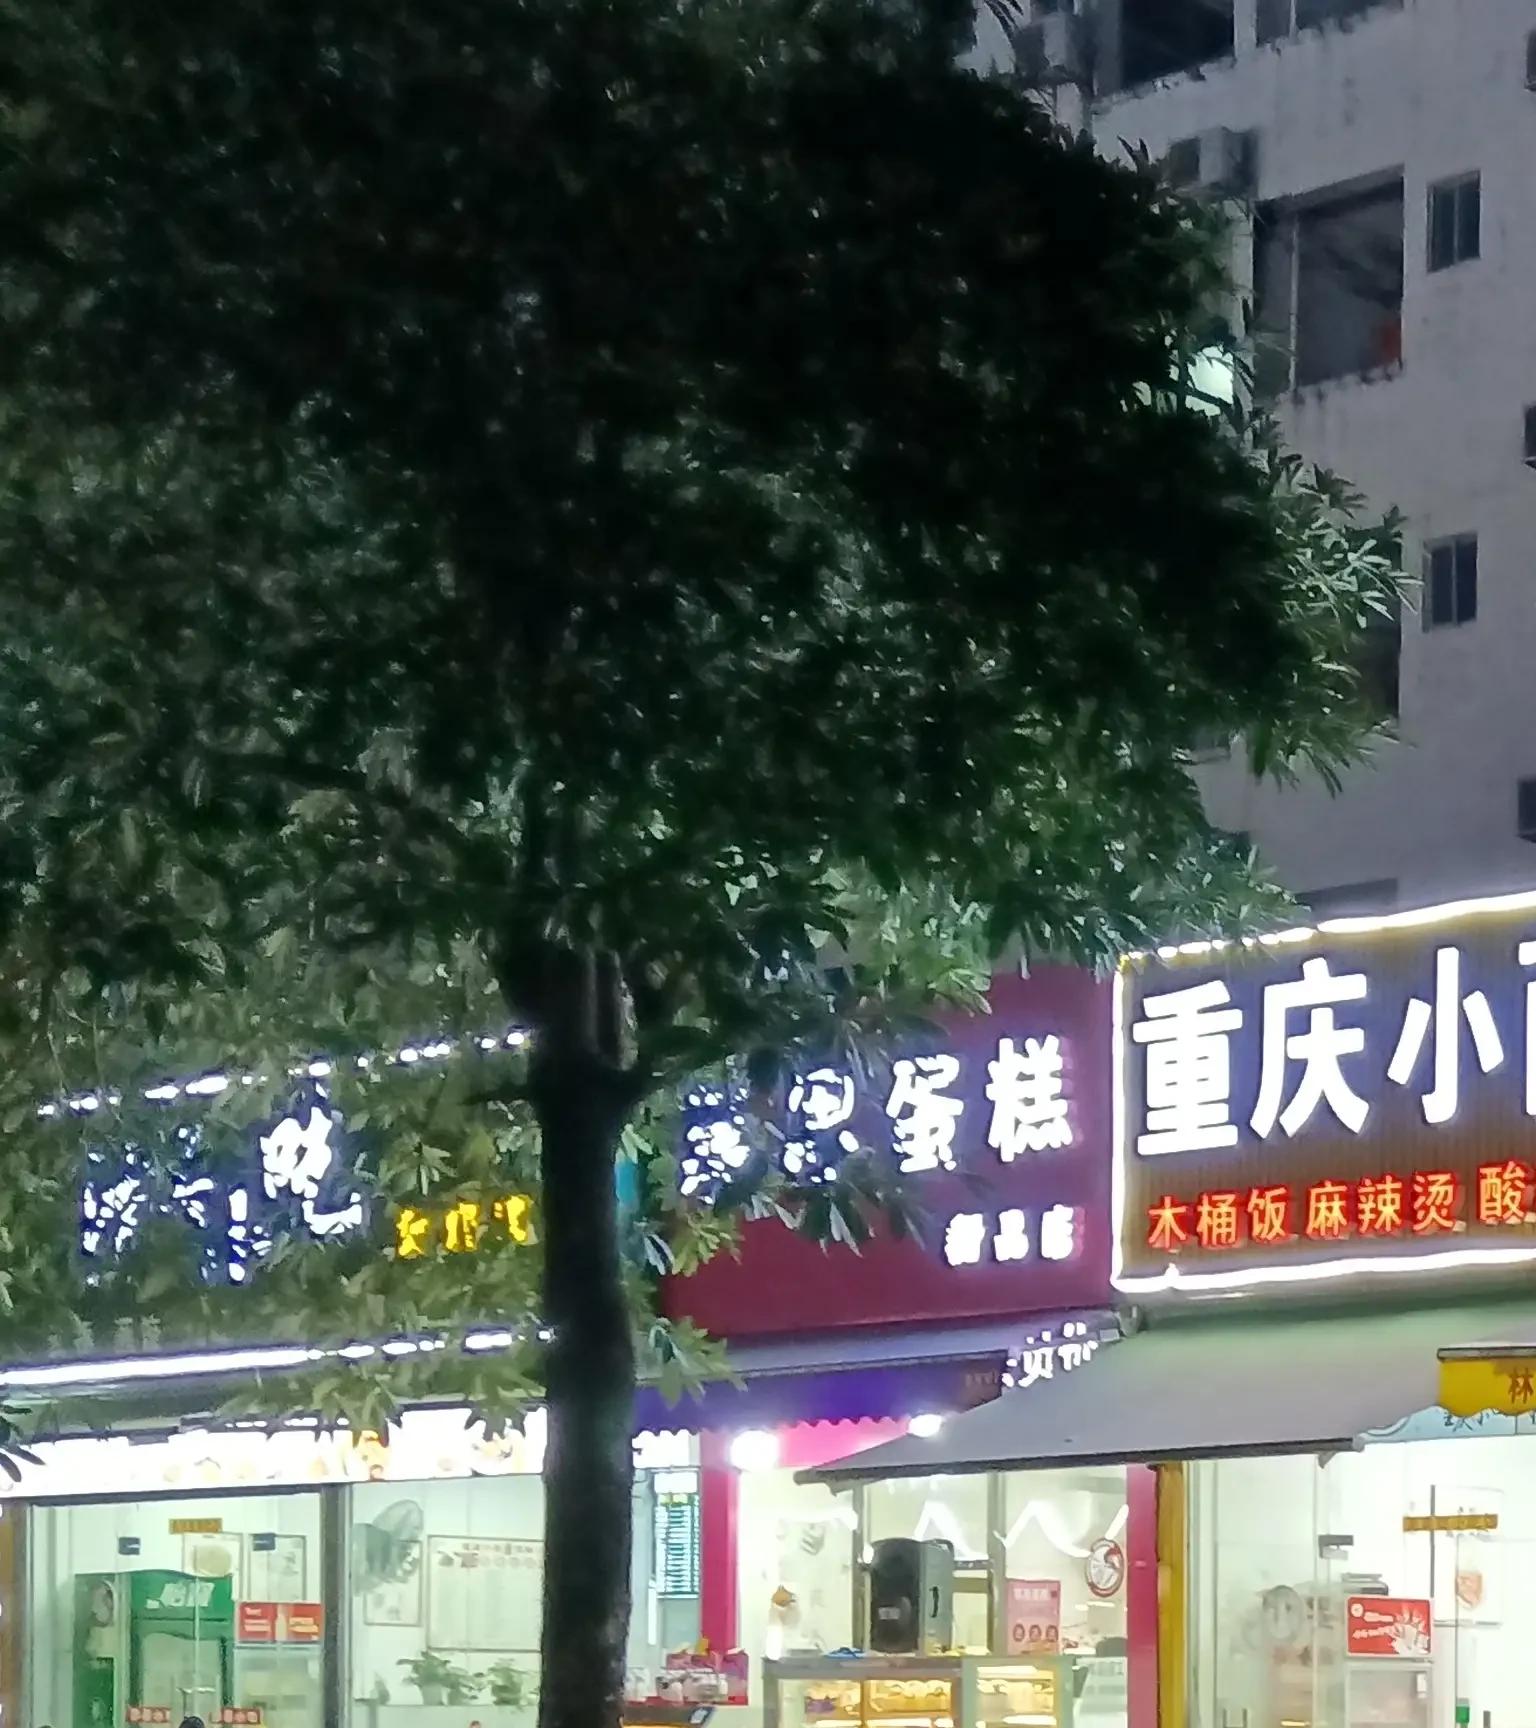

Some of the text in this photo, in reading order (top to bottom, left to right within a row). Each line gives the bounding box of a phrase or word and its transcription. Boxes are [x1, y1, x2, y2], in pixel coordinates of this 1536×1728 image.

[1146, 1184, 1289, 1251] 木桶饭
[1305, 1170, 1460, 1238] 麻辣烫
